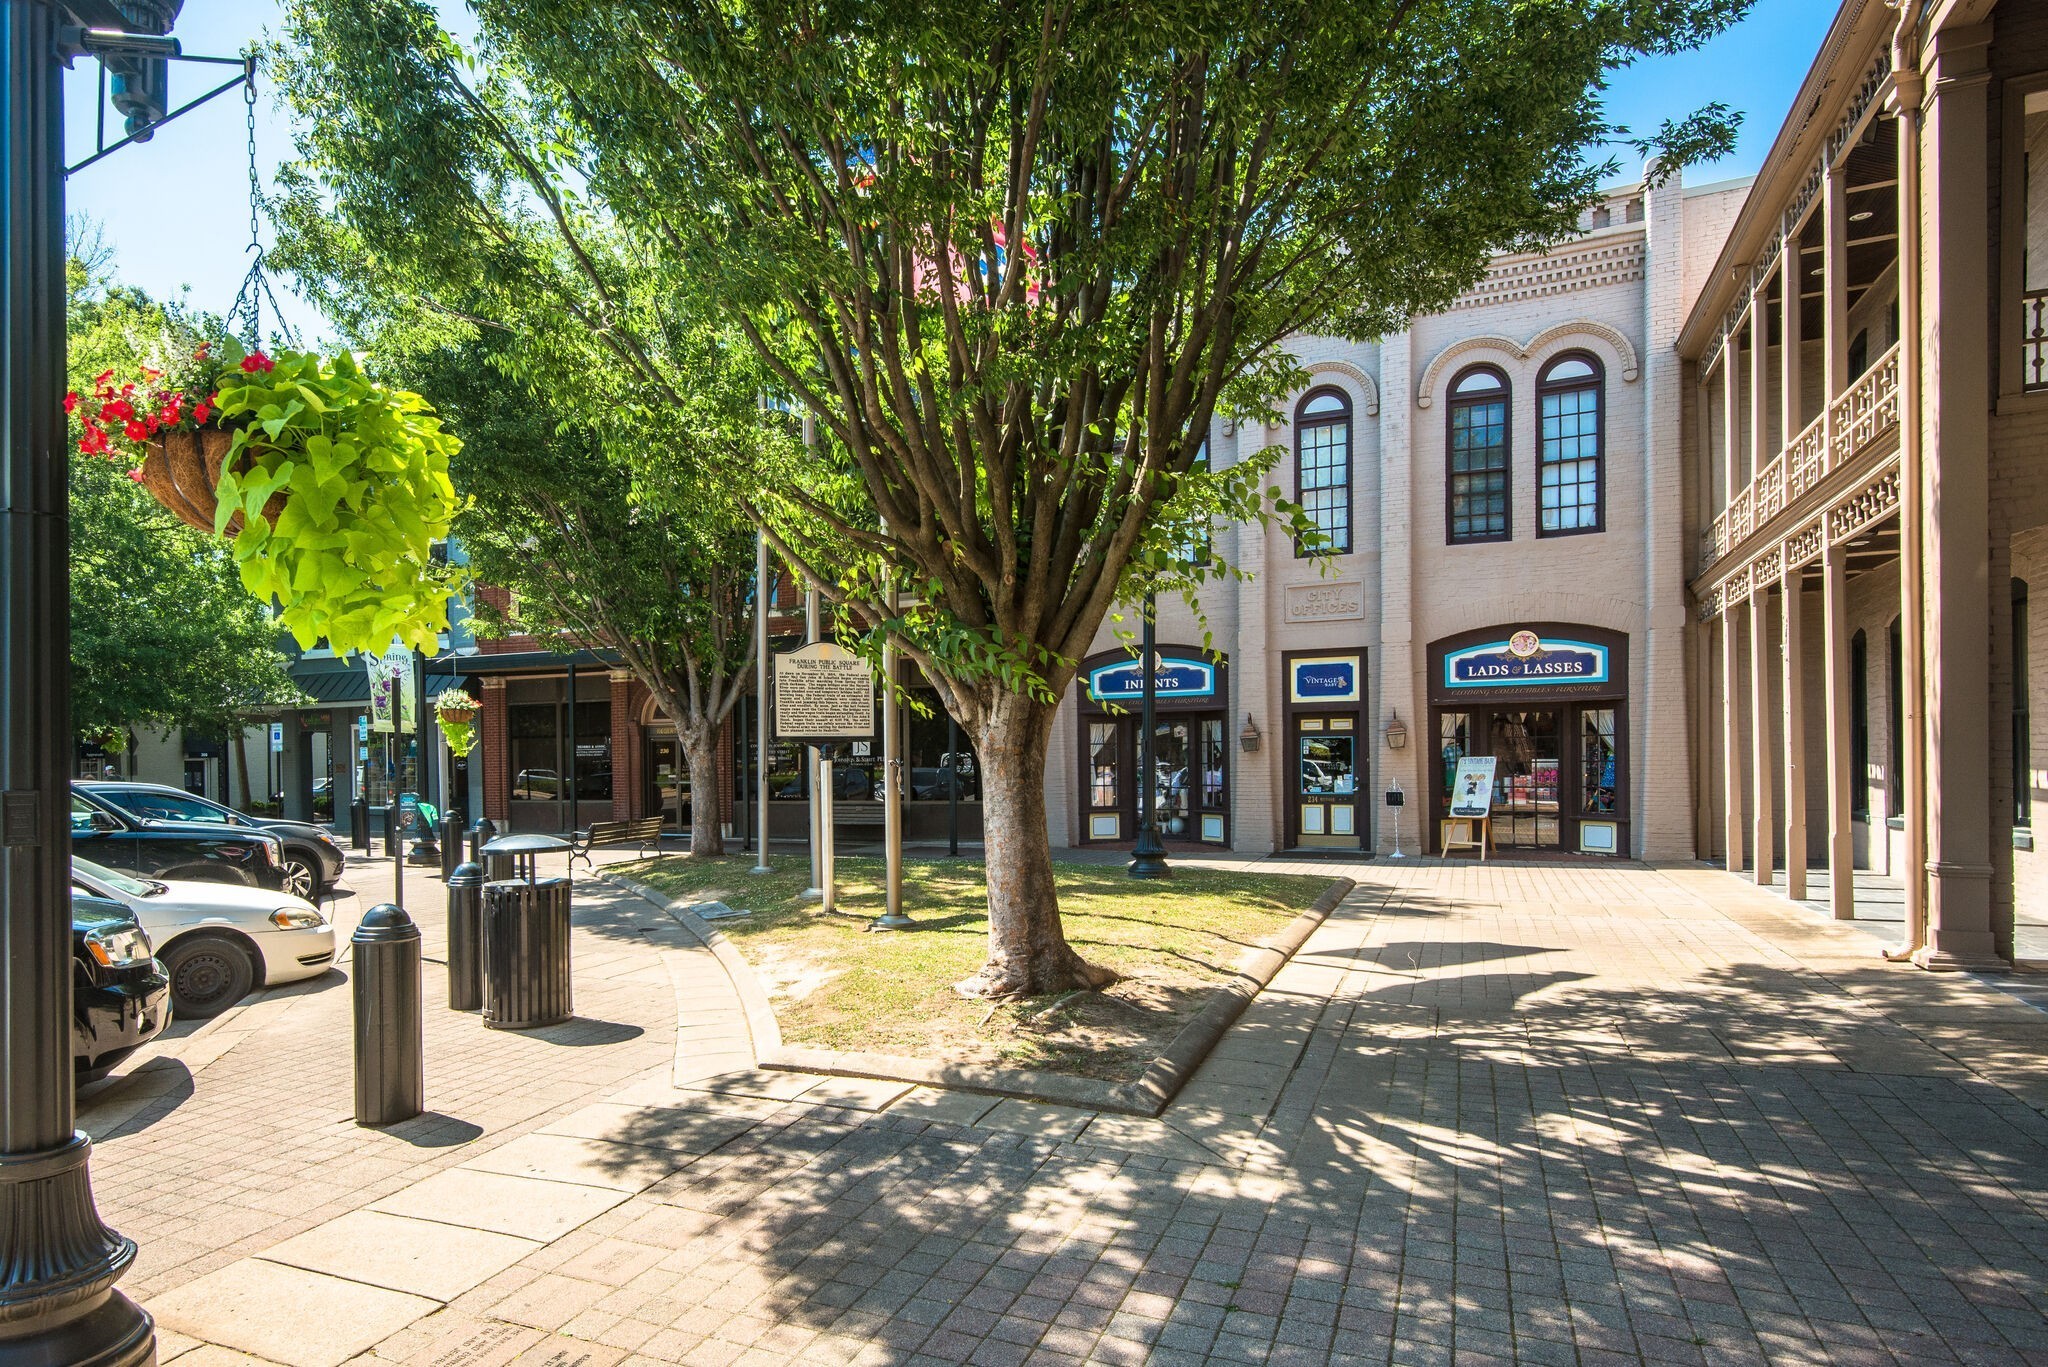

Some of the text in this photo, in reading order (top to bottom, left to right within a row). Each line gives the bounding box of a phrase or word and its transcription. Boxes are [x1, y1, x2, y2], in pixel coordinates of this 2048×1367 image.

[1307, 589, 1343, 601] CITY
[1292, 602, 1359, 616] OFFICES
[1468, 665, 1509, 677] LADS
[1523, 662, 1583, 675] LASSES
[1125, 678, 1179, 689] INNTS
